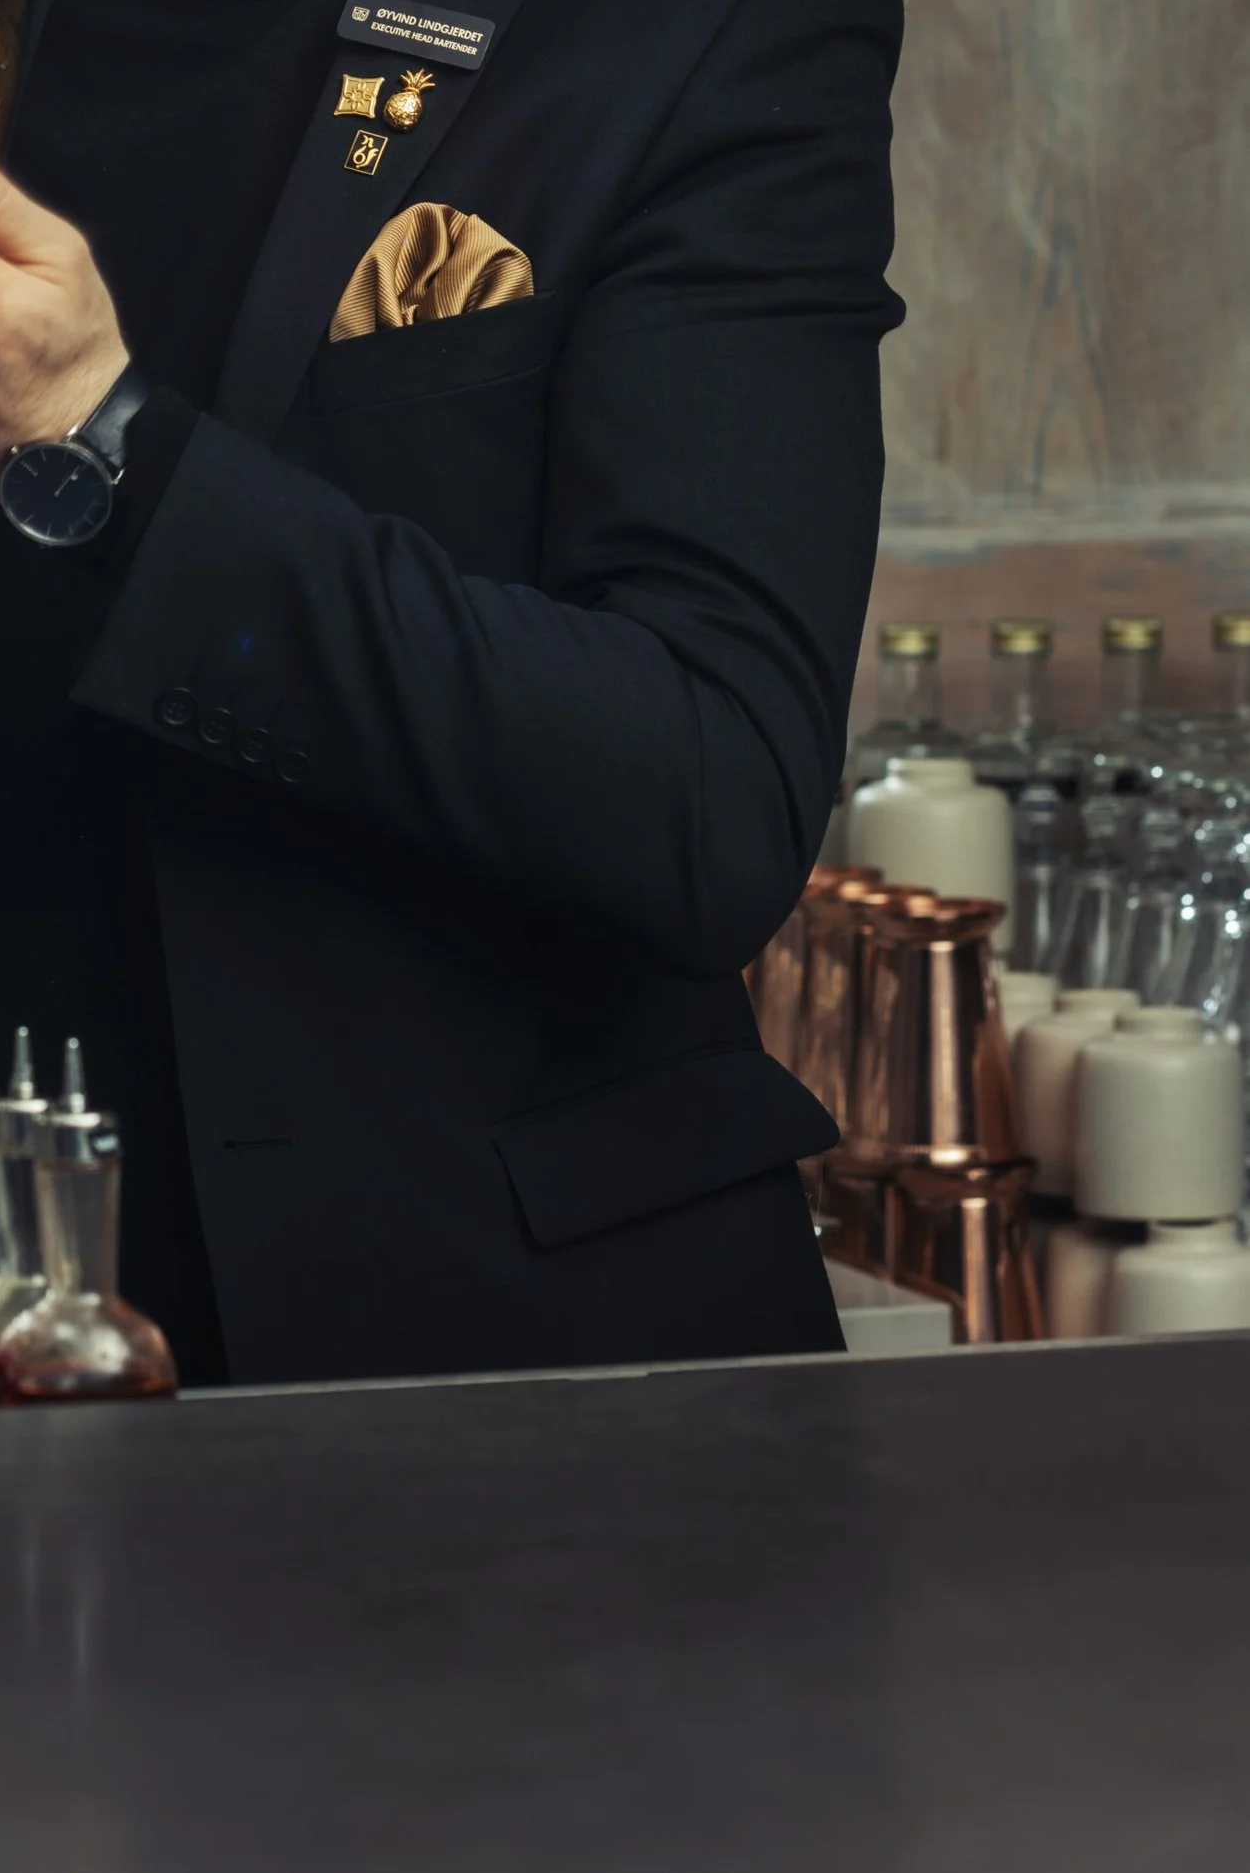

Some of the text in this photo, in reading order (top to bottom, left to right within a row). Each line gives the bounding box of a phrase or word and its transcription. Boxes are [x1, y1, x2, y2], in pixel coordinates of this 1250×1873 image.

[371, 21, 478, 56] EXECUTIVE HEAD BARTENDER
[376, 8, 484, 43] ØYVIND LINDGJERDET
